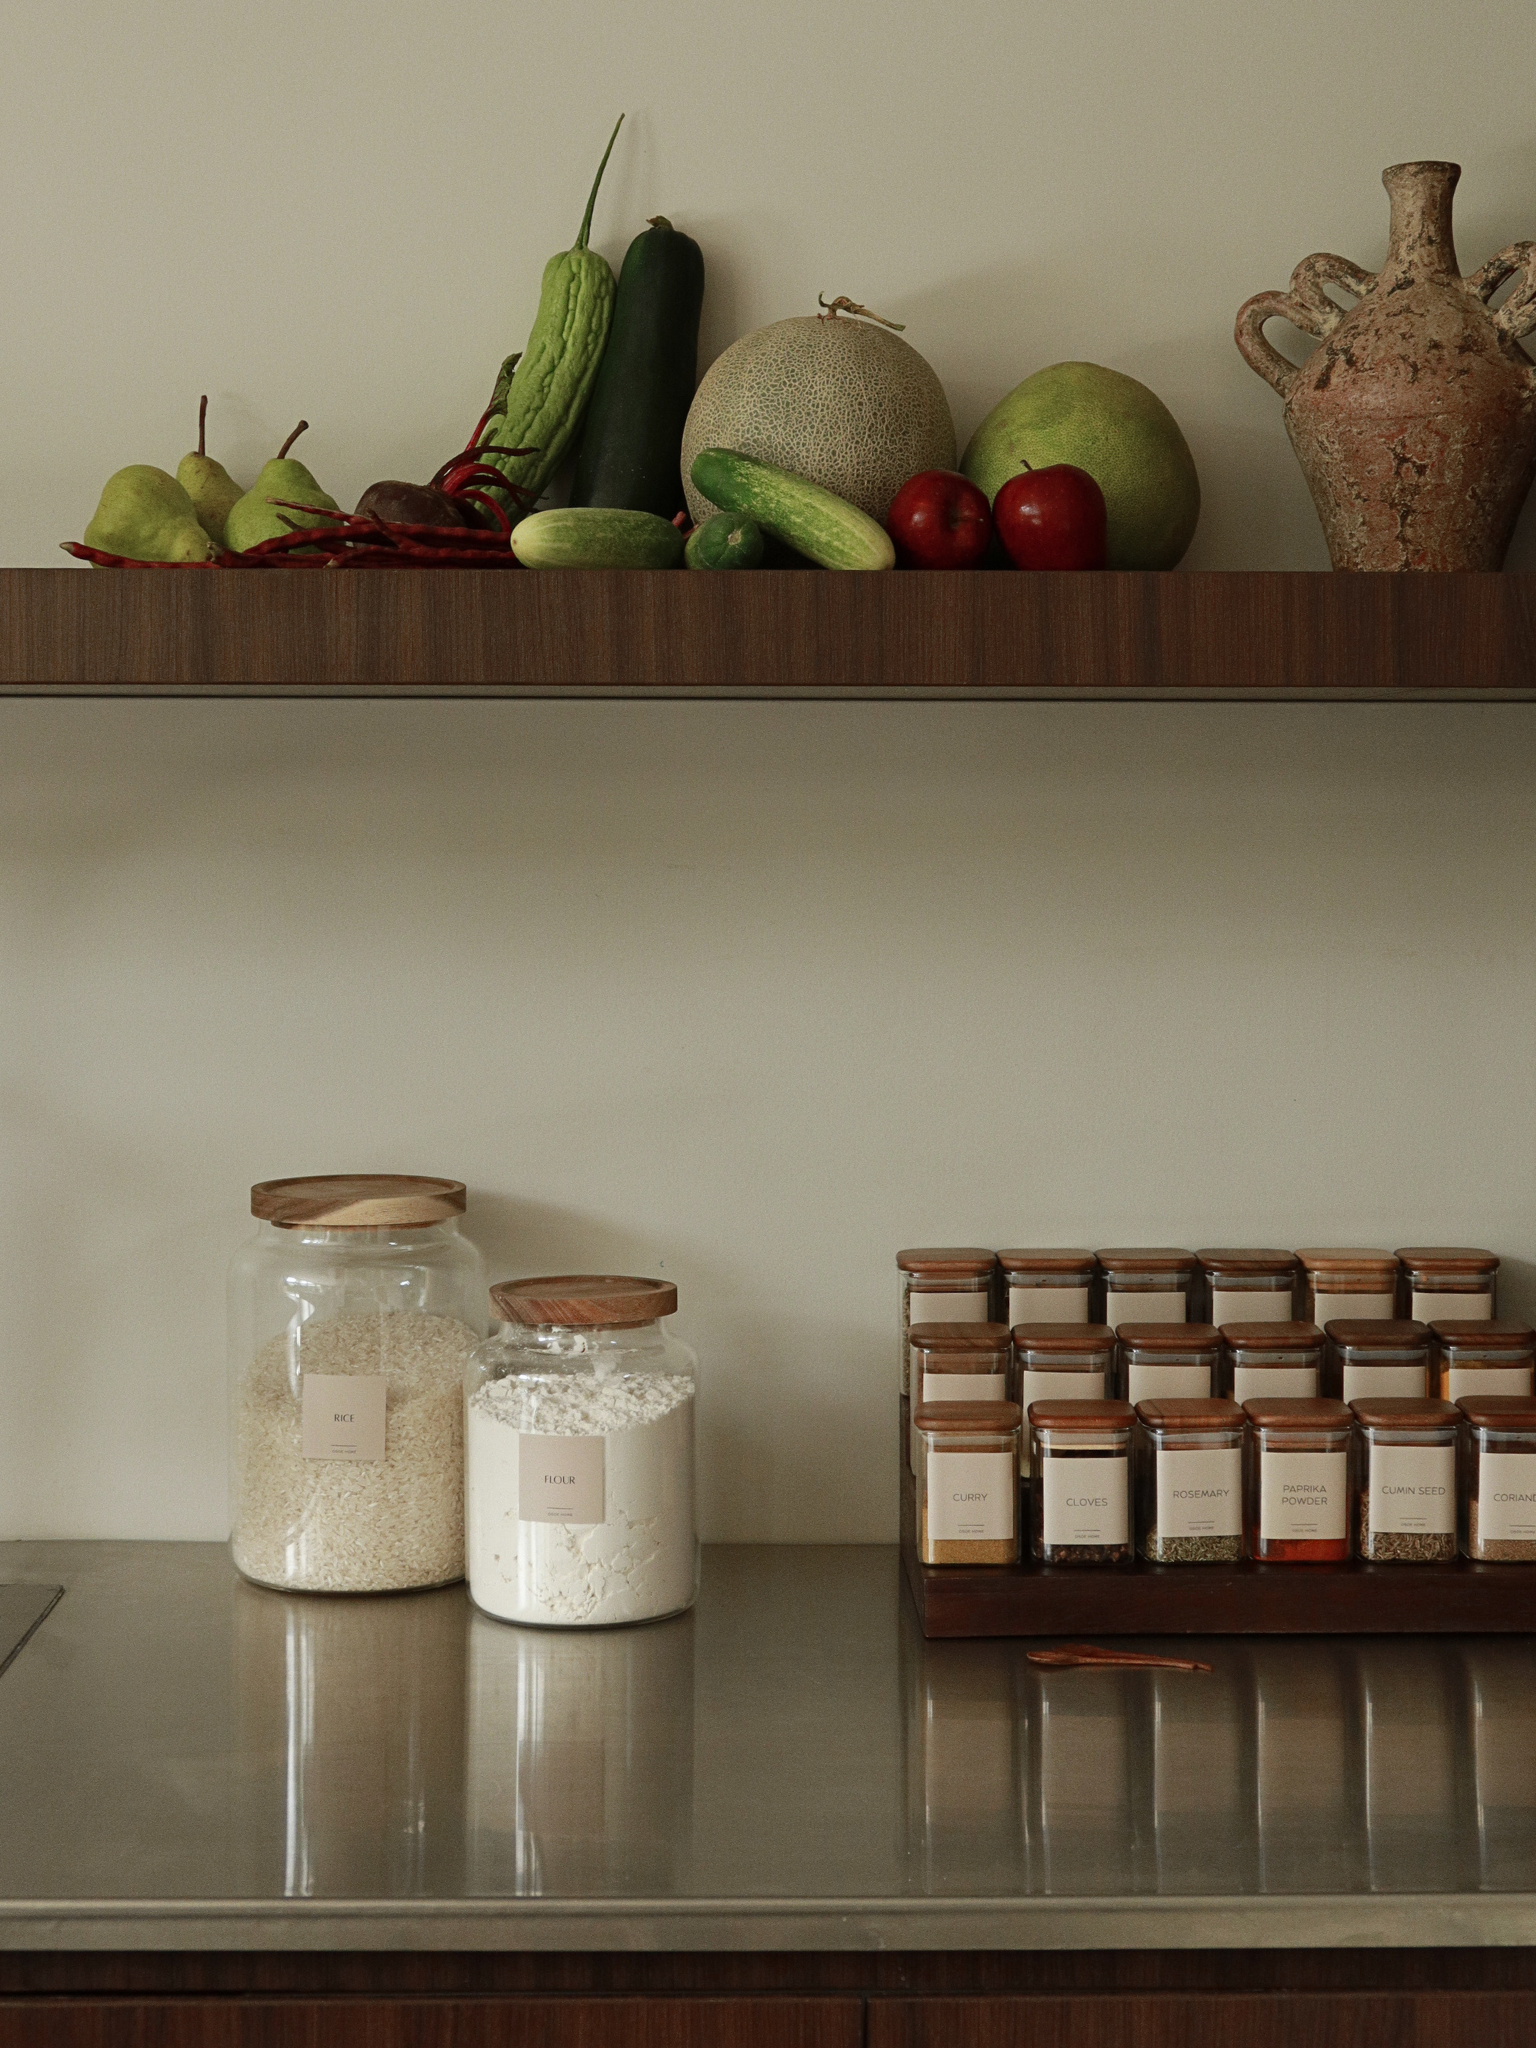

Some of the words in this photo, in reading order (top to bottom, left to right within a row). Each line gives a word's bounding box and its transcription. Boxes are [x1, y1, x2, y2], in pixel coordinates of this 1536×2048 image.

[333, 1413, 355, 1423] RICE
[544, 1475, 576, 1485] FLOUR
[1283, 1485, 1327, 1493] PAPRIKA
[1381, 1486, 1416, 1495] CUMIN
[1418, 1486, 1446, 1496] SEED
[952, 1493, 988, 1502] CURRY
[1173, 1489, 1230, 1499] ROSEMARY
[1066, 1498, 1108, 1507] CLOVES
[1282, 1497, 1328, 1506] POWDER
